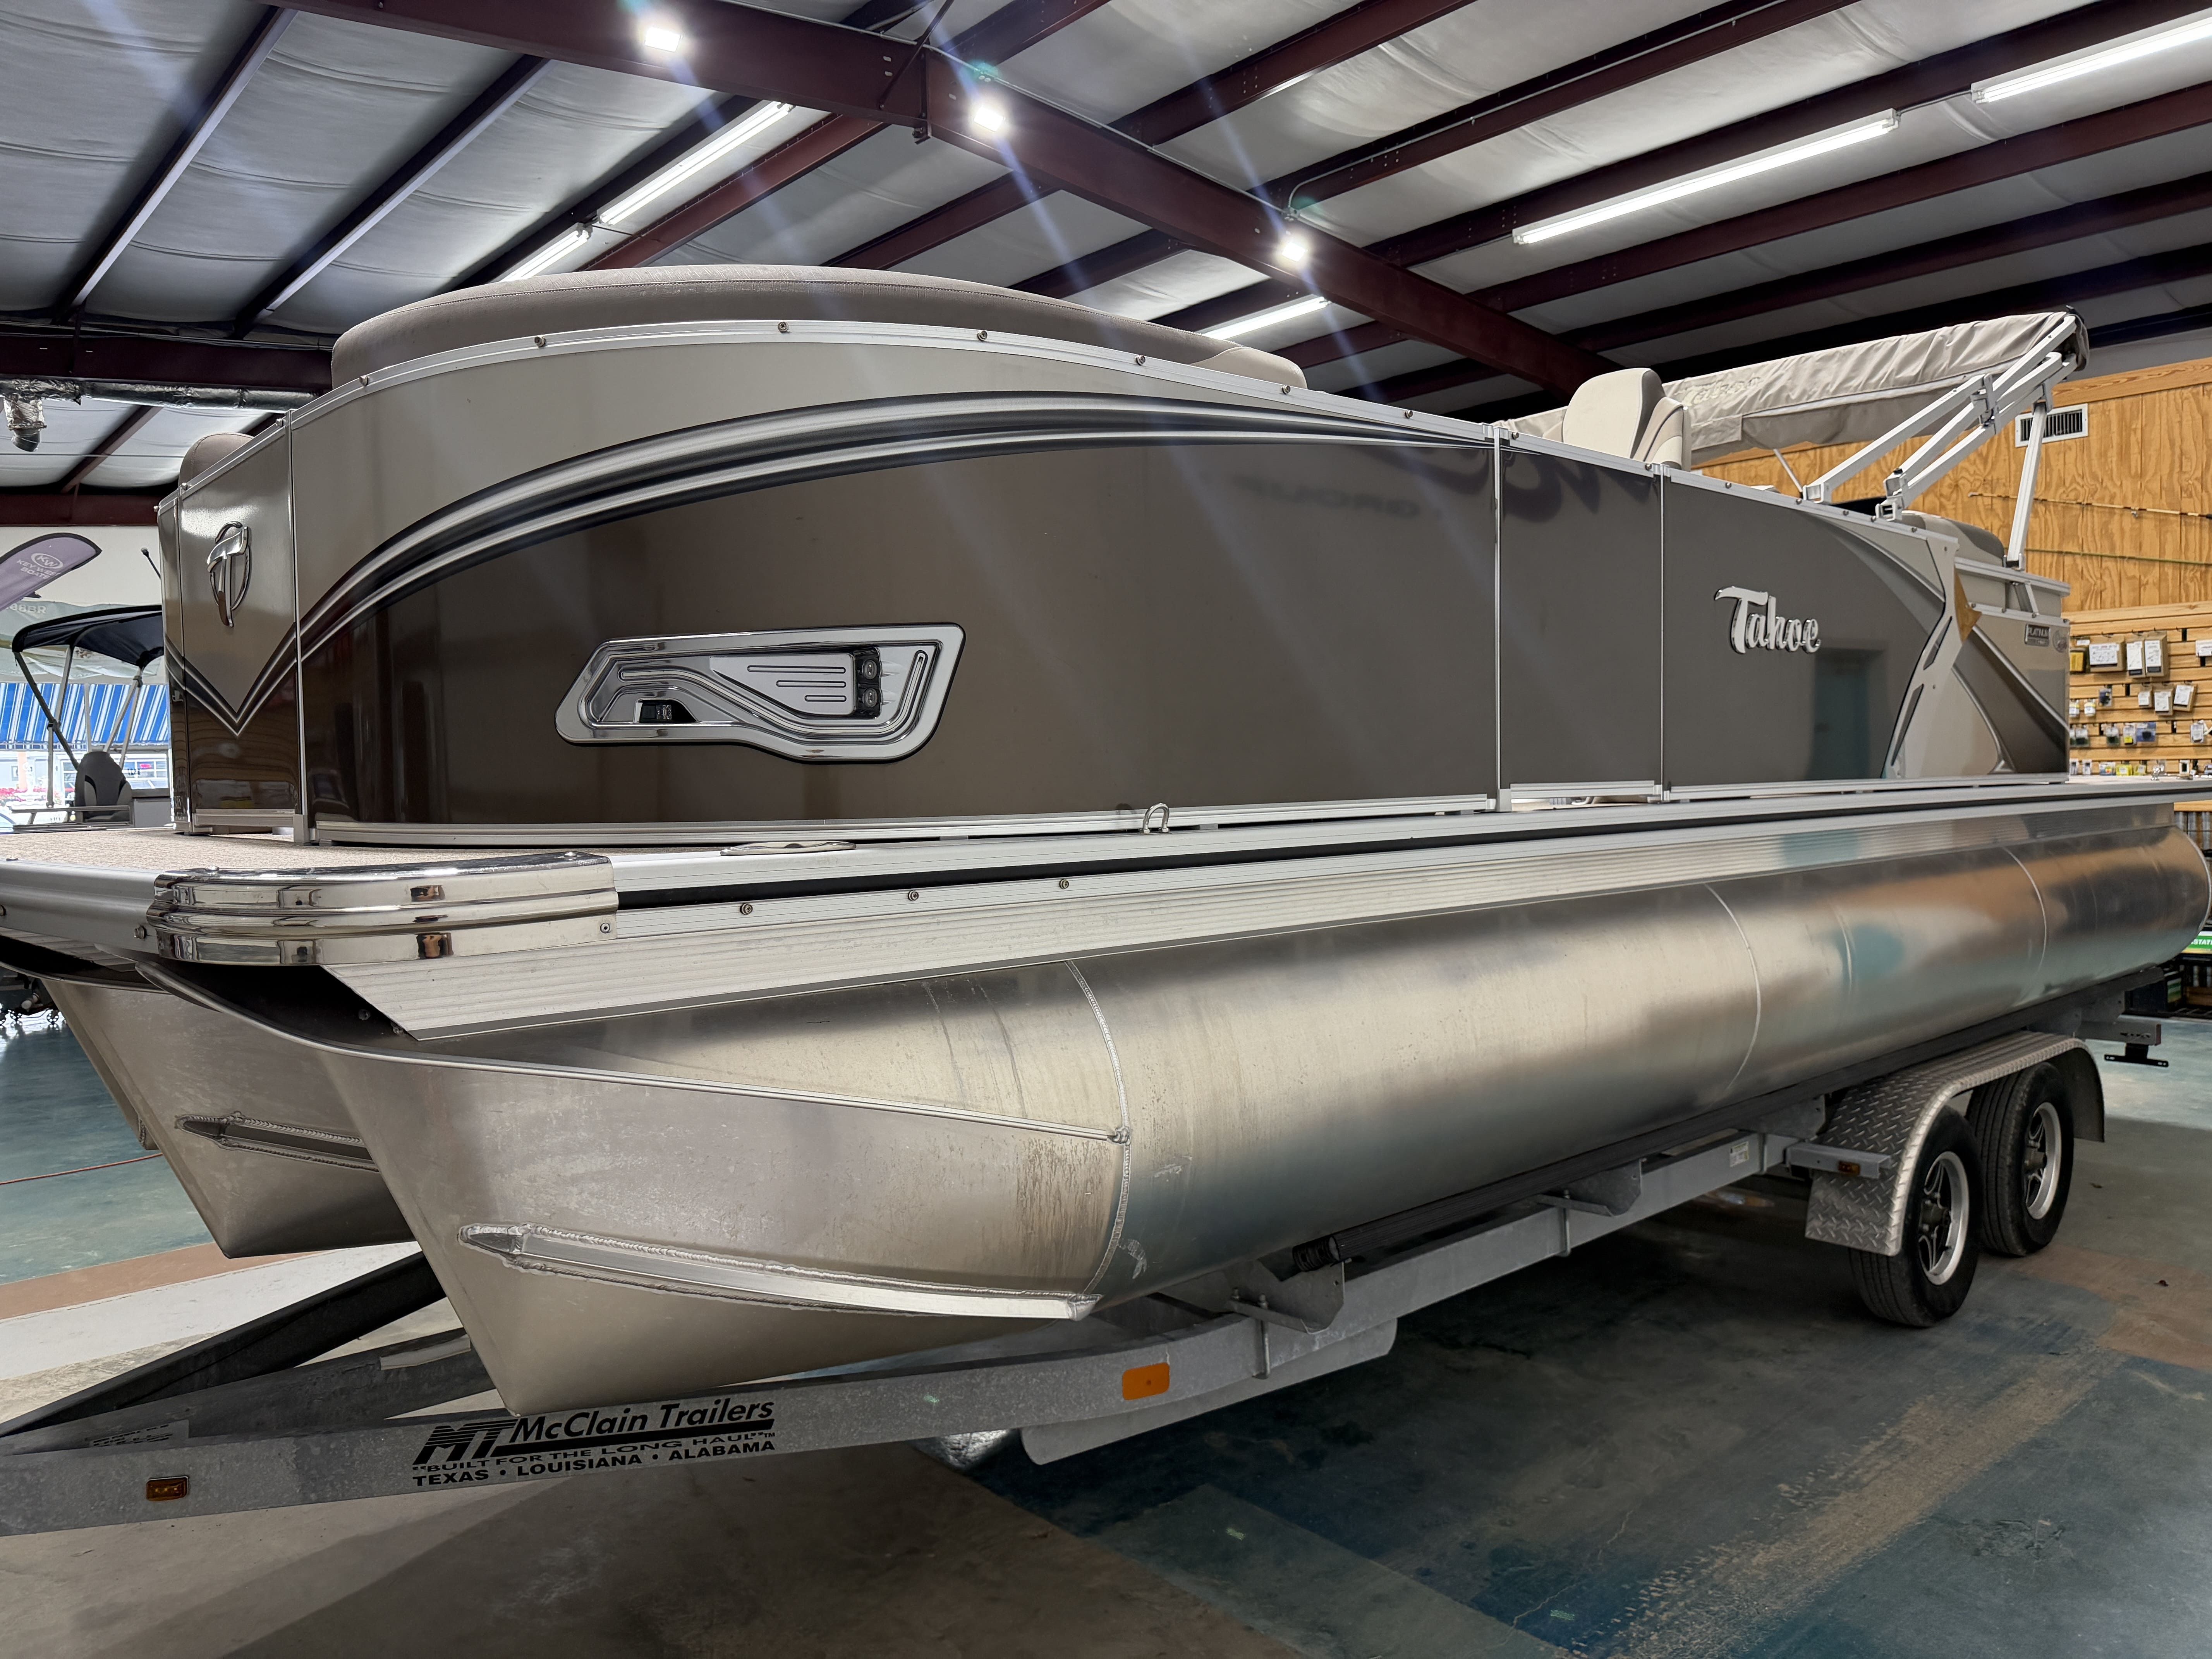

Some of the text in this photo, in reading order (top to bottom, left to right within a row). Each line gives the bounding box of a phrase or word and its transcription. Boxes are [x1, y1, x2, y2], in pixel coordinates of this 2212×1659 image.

[16, 559, 36, 568] KEY
[20, 567, 51, 579] BOATS
[37, 555, 58, 567] KW
[1714, 586, 1821, 654] Tahoe
[509, 1398, 775, 1443] McClain Trailers
[412, 1441, 775, 1486] TEXAS LOUISIANA ALABAMA
[496, 1455, 542, 1465] FOR
[549, 1449, 591, 1460] THE
[601, 1441, 682, 1455] LONG
